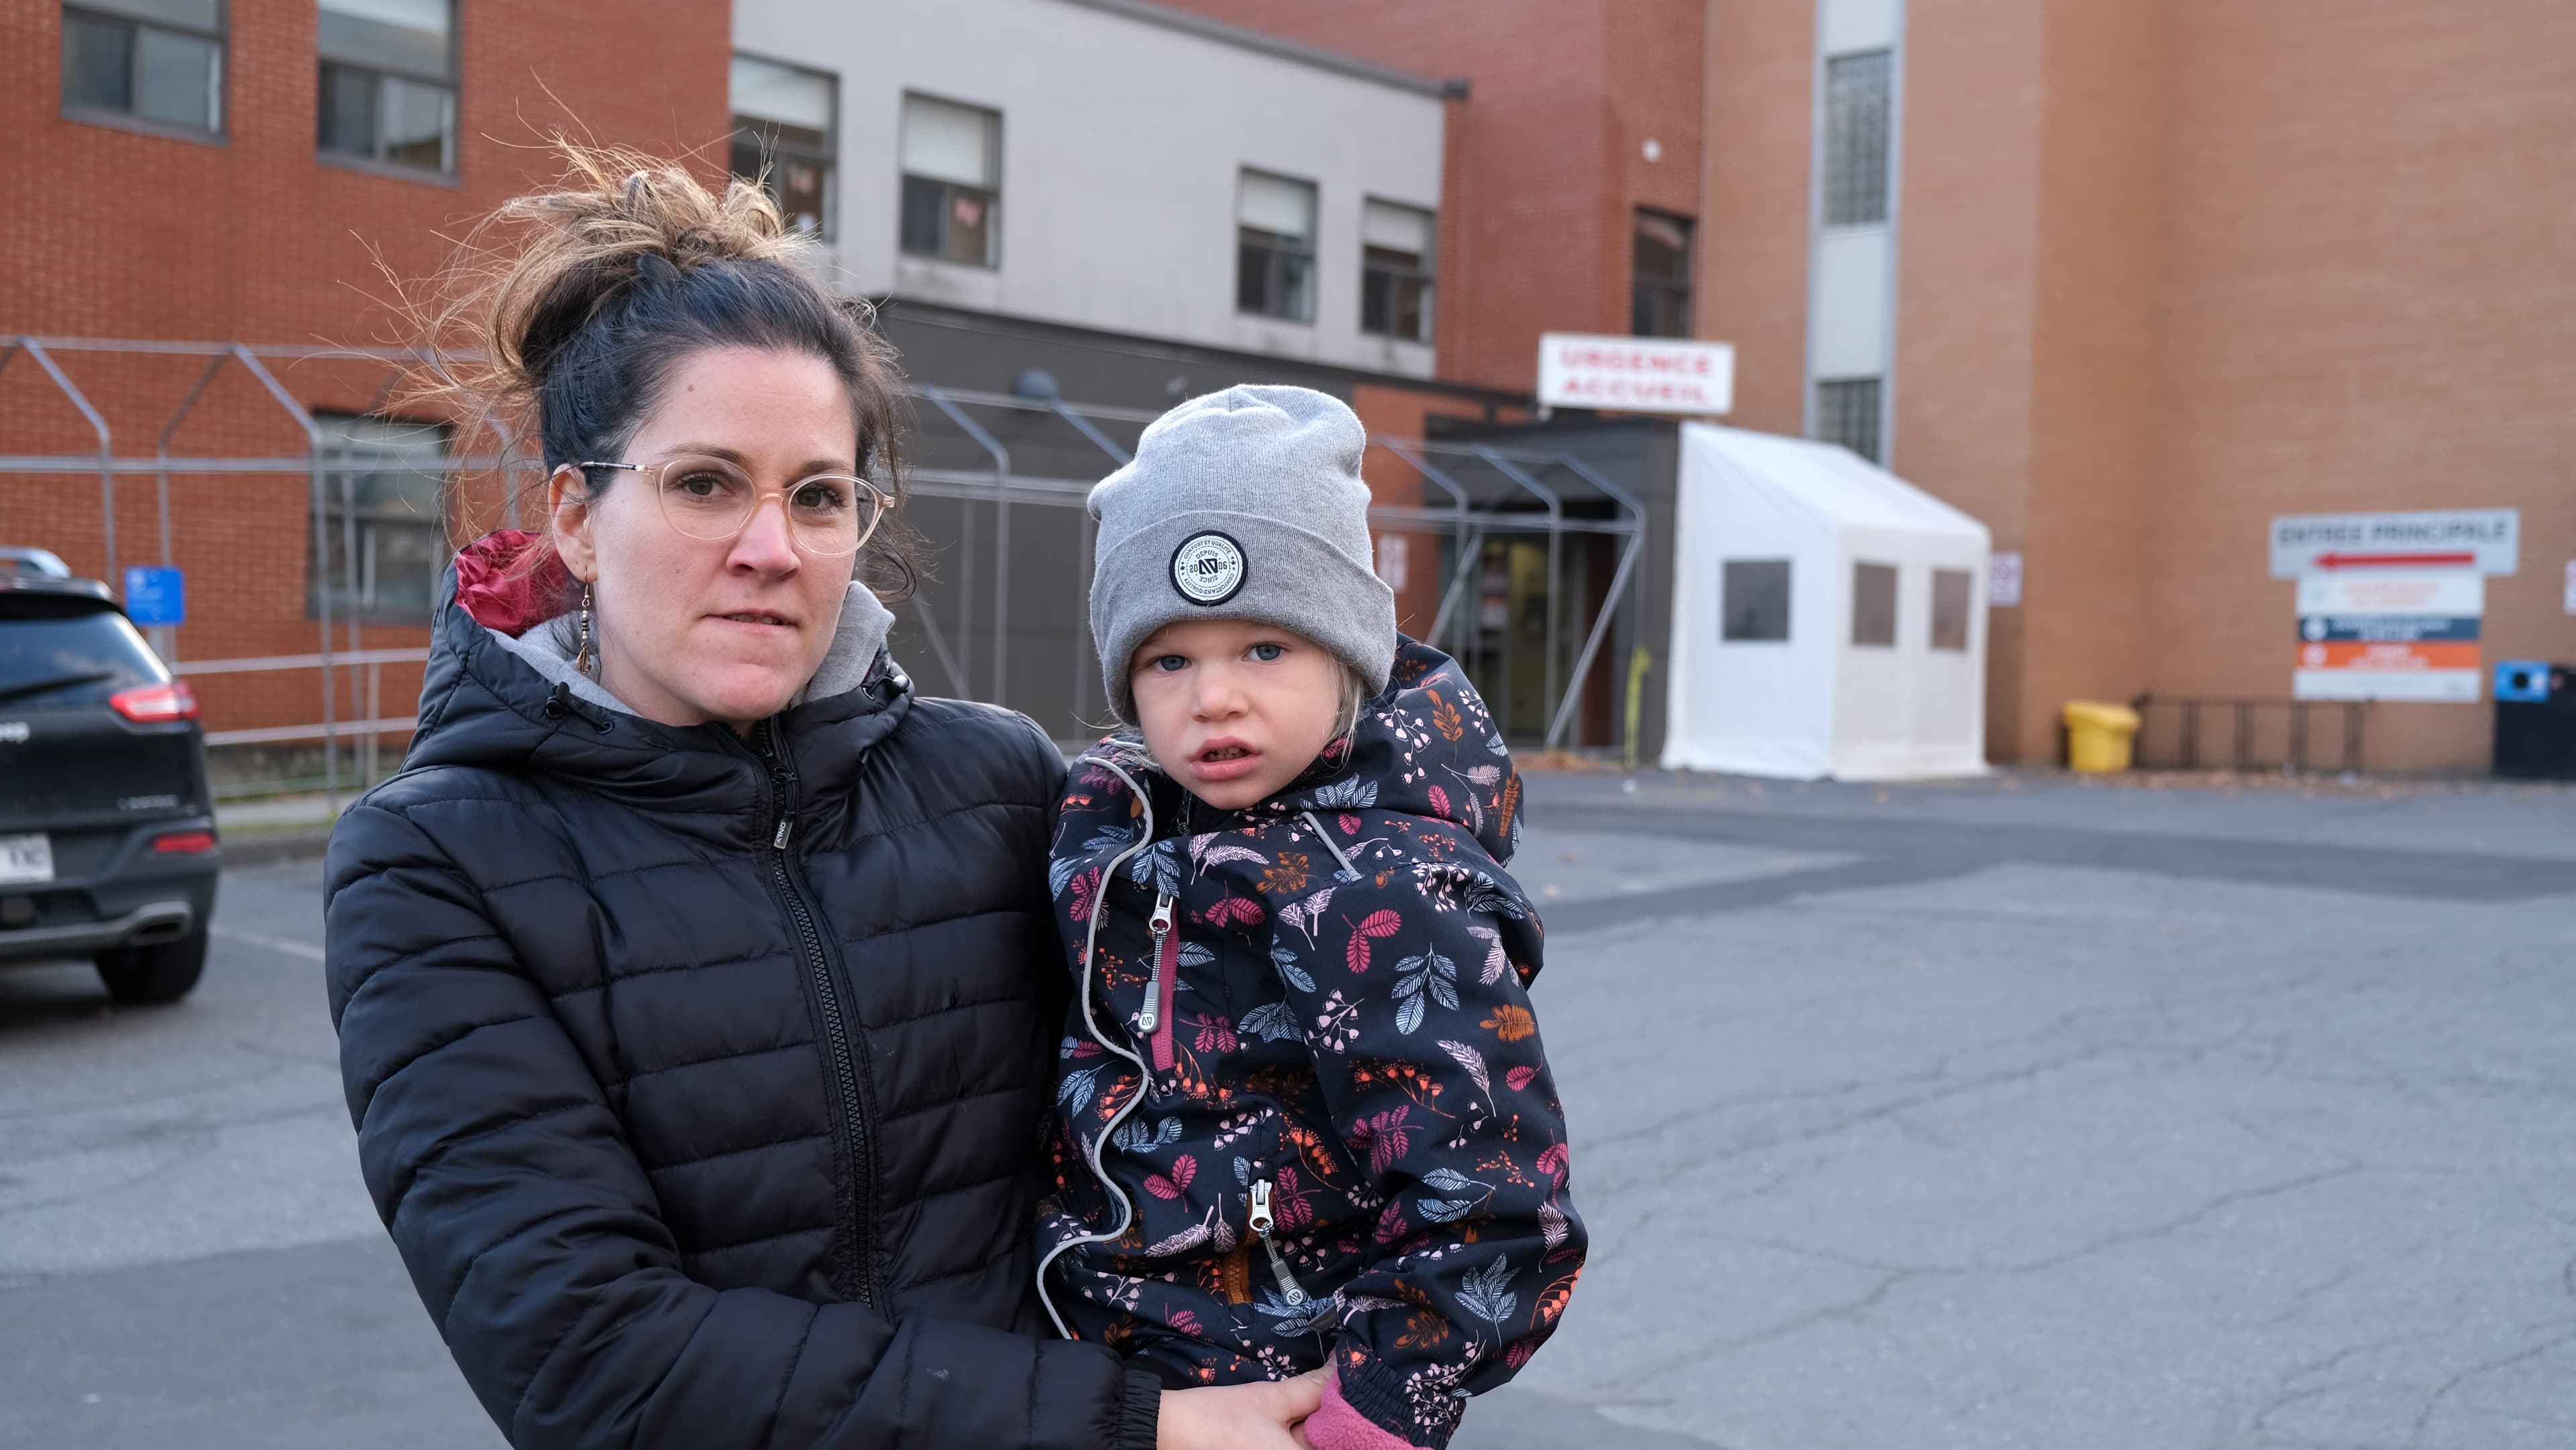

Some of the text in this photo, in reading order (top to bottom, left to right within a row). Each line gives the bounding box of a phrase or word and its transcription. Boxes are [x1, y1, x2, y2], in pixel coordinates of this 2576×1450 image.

[1561, 350, 1710, 373] URGENCE
[1563, 378, 1705, 401] ACCUEIL
[2371, 519, 2508, 543] PRINCIPALE
[1184, 541, 1203, 559] CONFORT
[1195, 550, 1218, 559] DEPUIS
[1189, 564, 1198, 573] 20
[1218, 562, 1228, 570] 06
[1184, 578, 1203, 593] QUALITY
[1199, 575, 1218, 583] SINCE
[777, 822, 786, 843] ONLY
